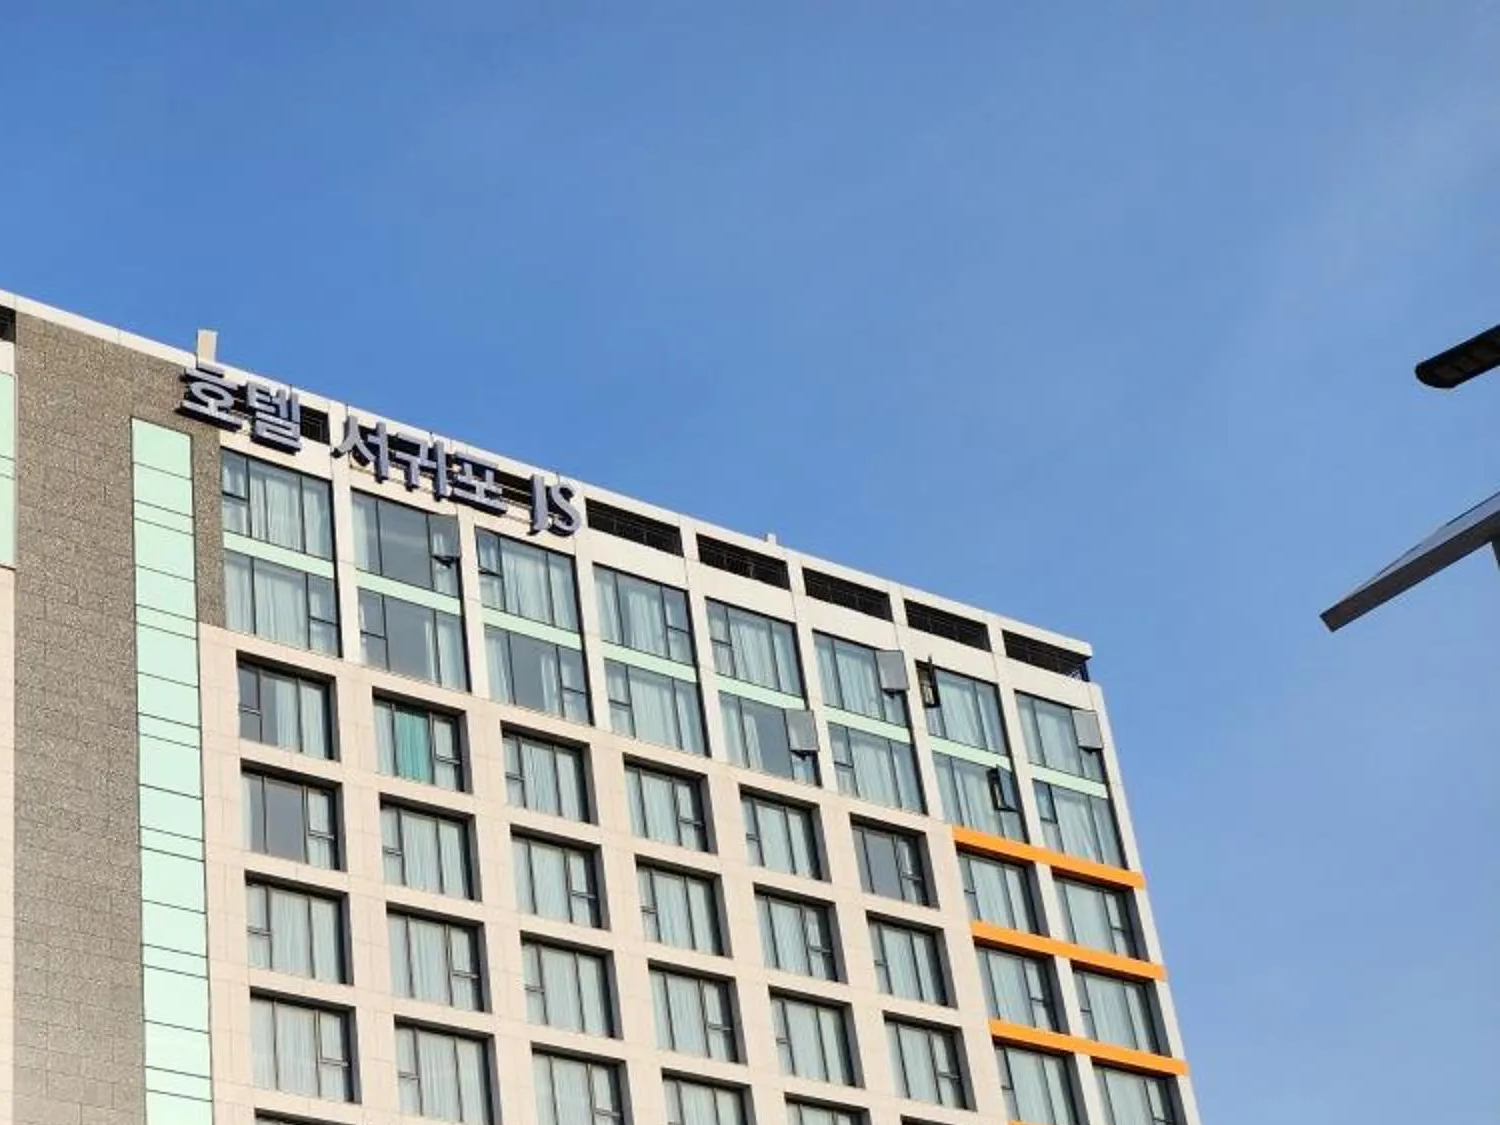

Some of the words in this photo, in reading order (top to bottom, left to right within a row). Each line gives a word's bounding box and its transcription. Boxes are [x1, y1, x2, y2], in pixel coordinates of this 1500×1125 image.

[179, 366, 301, 454] 호텔
[333, 414, 508, 514] 서귀포
[528, 473, 582, 535] JS
